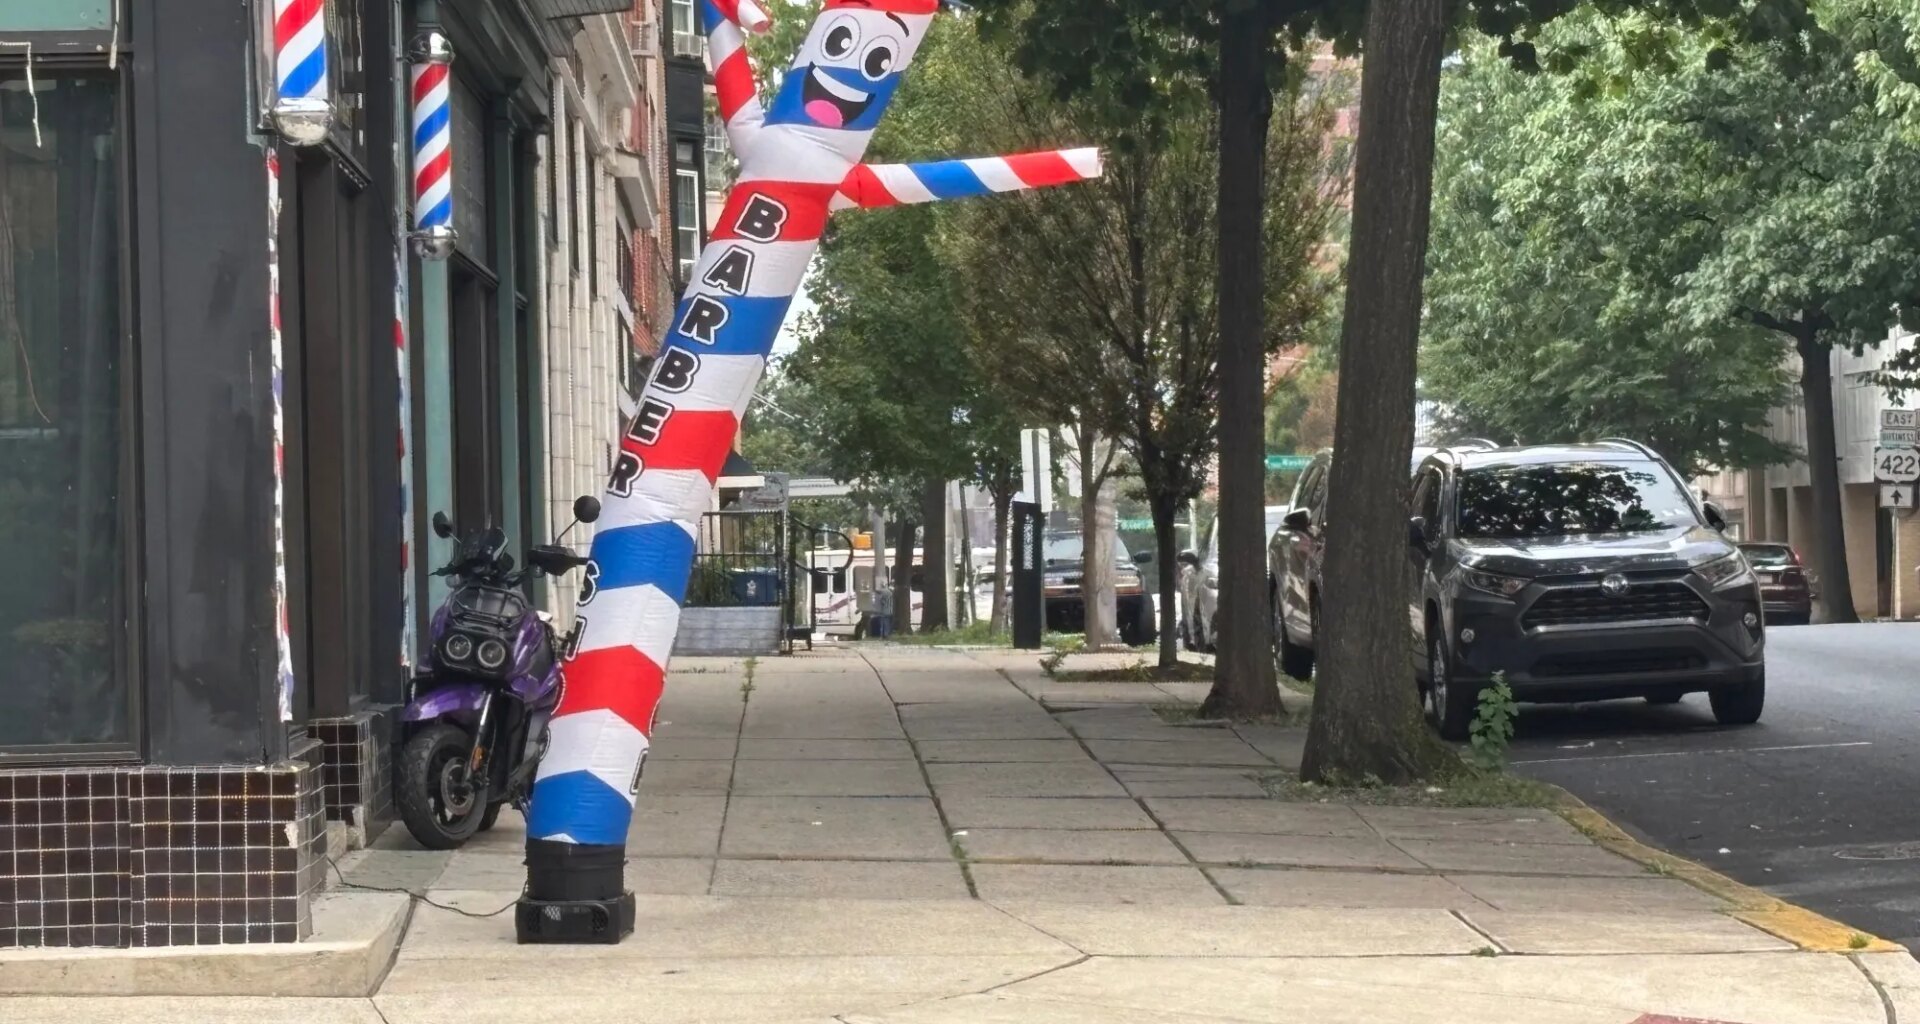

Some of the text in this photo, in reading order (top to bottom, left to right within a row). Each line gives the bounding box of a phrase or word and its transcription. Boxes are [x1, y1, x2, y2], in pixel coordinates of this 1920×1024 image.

[606, 192, 788, 498] BARBER
[1886, 412, 1913, 425] EAST
[1880, 455, 1915, 475] 422
